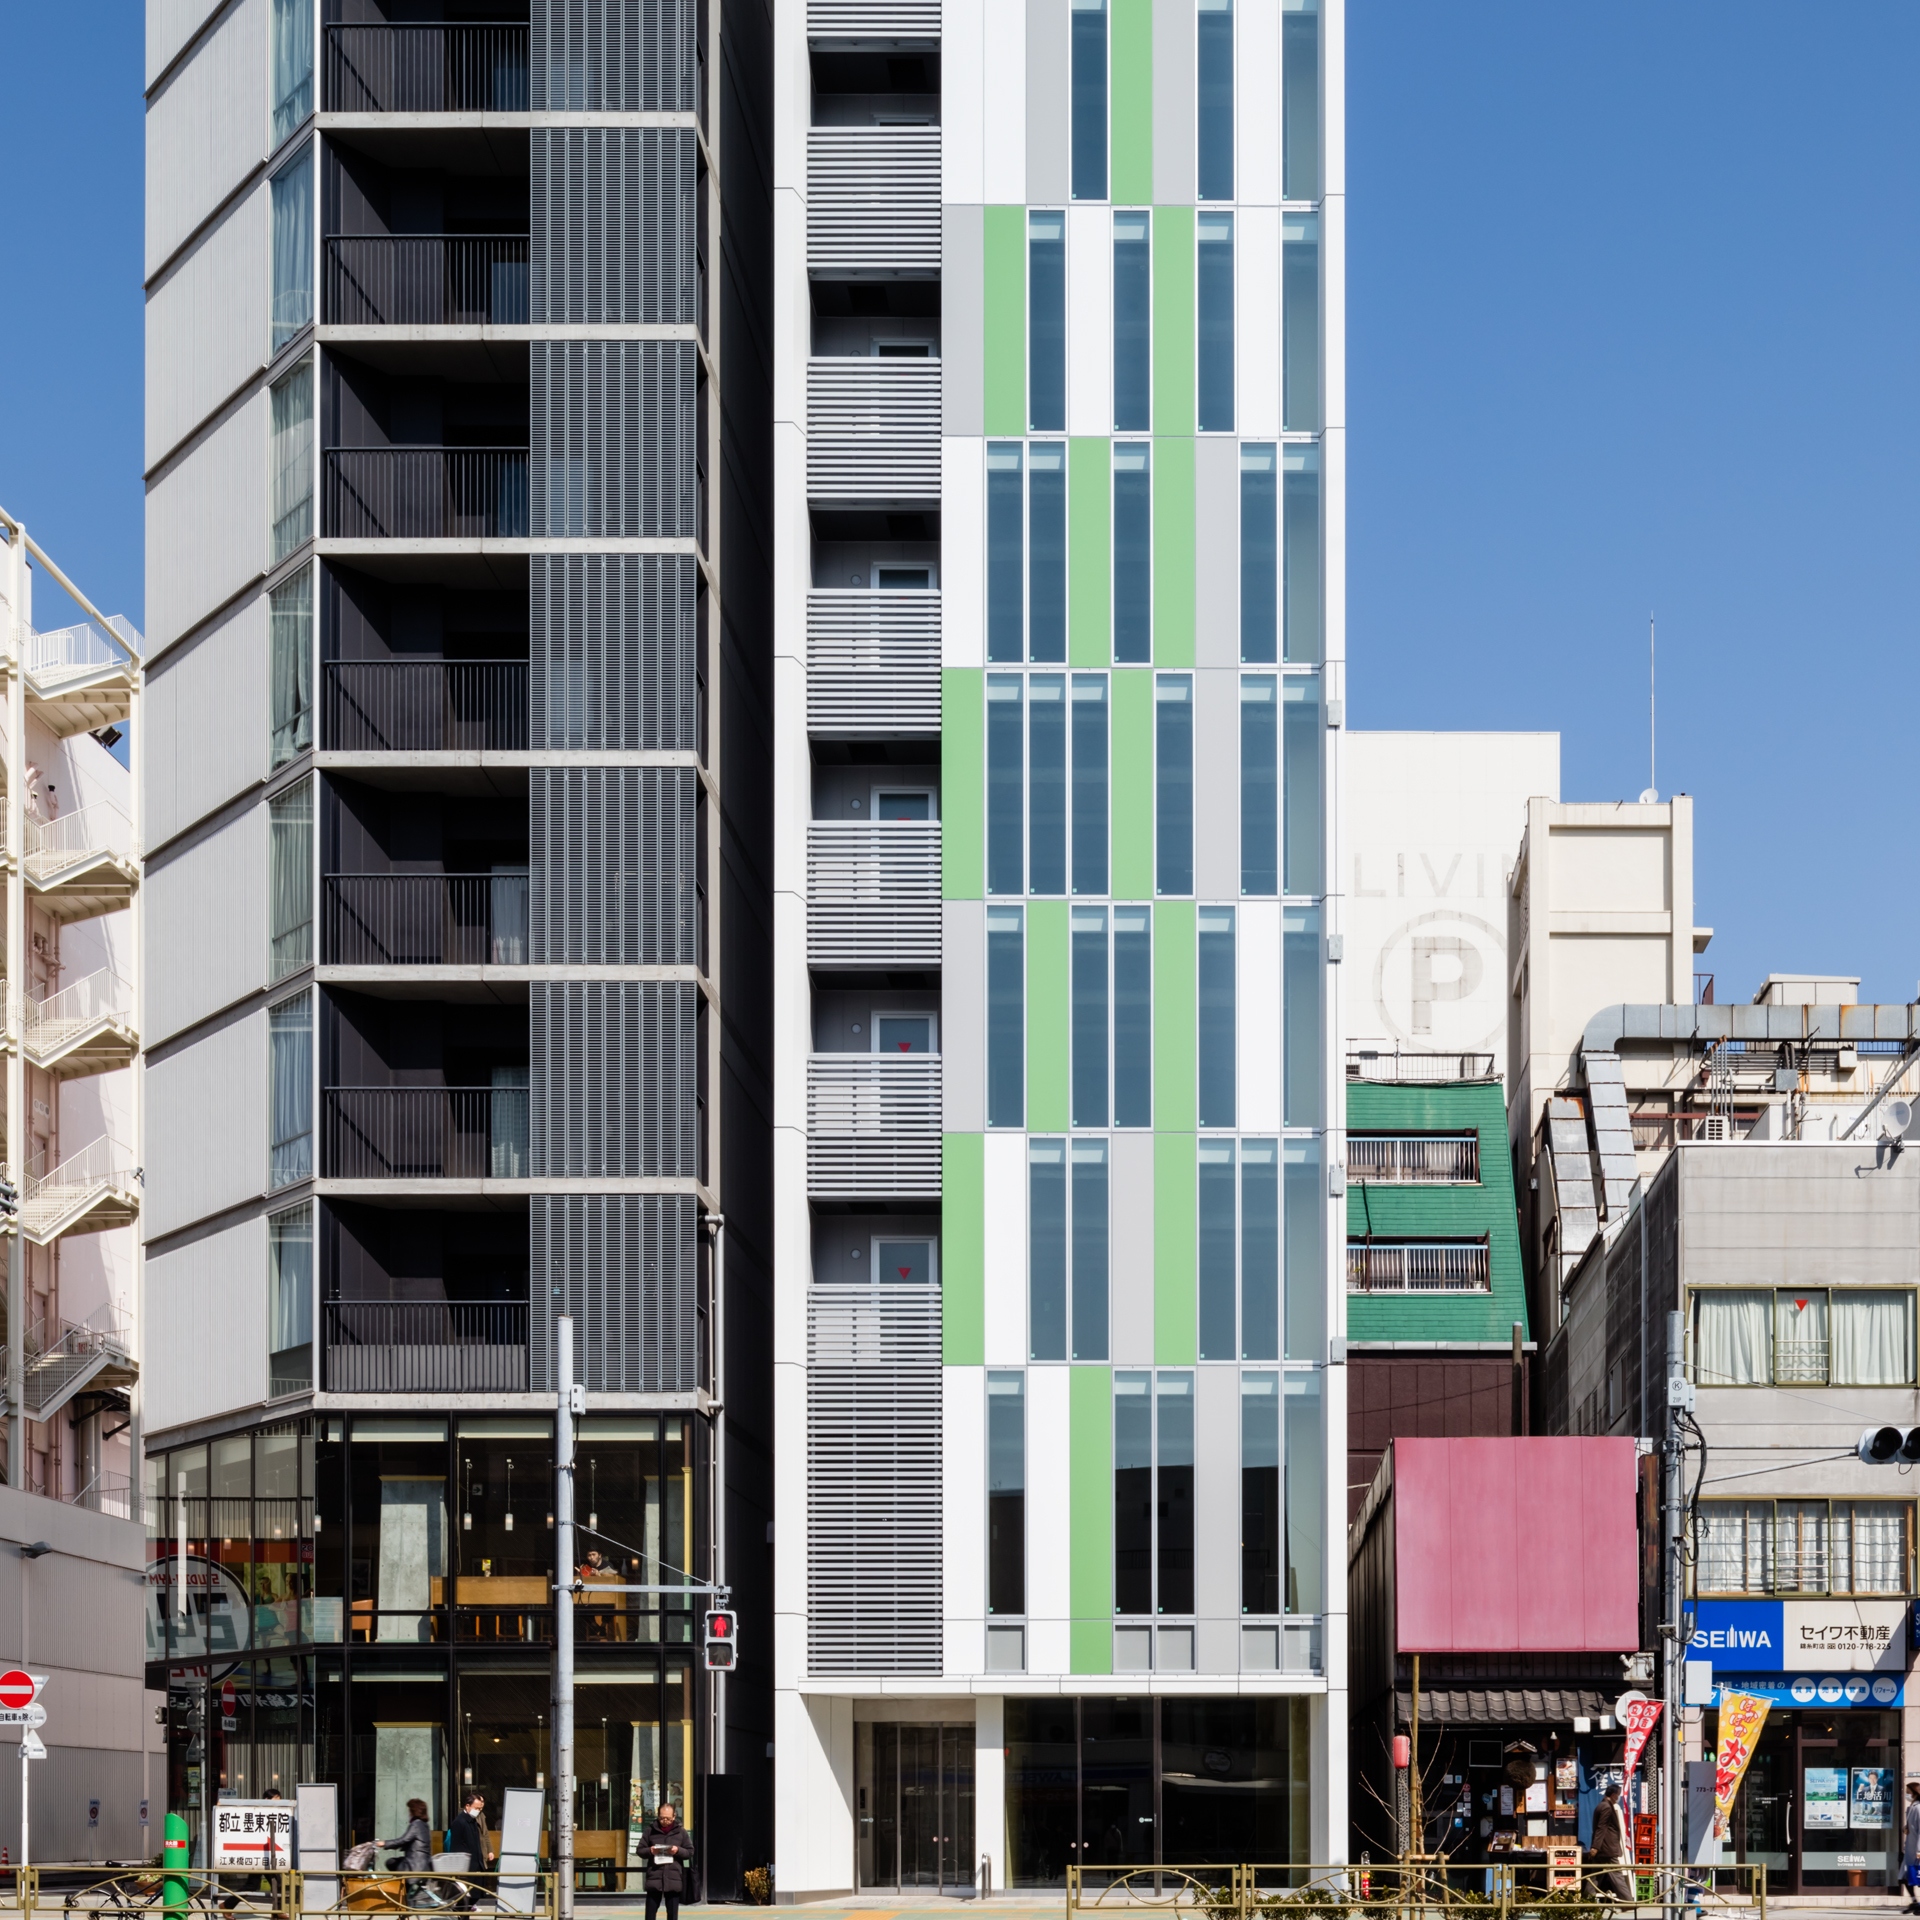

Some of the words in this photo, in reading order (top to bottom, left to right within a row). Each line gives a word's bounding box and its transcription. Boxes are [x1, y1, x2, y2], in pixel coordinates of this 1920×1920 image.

[1411, 936, 1484, 1035] P
[1692, 1624, 1772, 1648] SEIWA
[1800, 1625, 1891, 1641] セイワ不動産
[1837, 1643, 1892, 1651] 0120-718-225
[219, 1857, 287, 1867] 江東橋四丁目会
[1837, 1853, 1866, 1863] SEIWA
